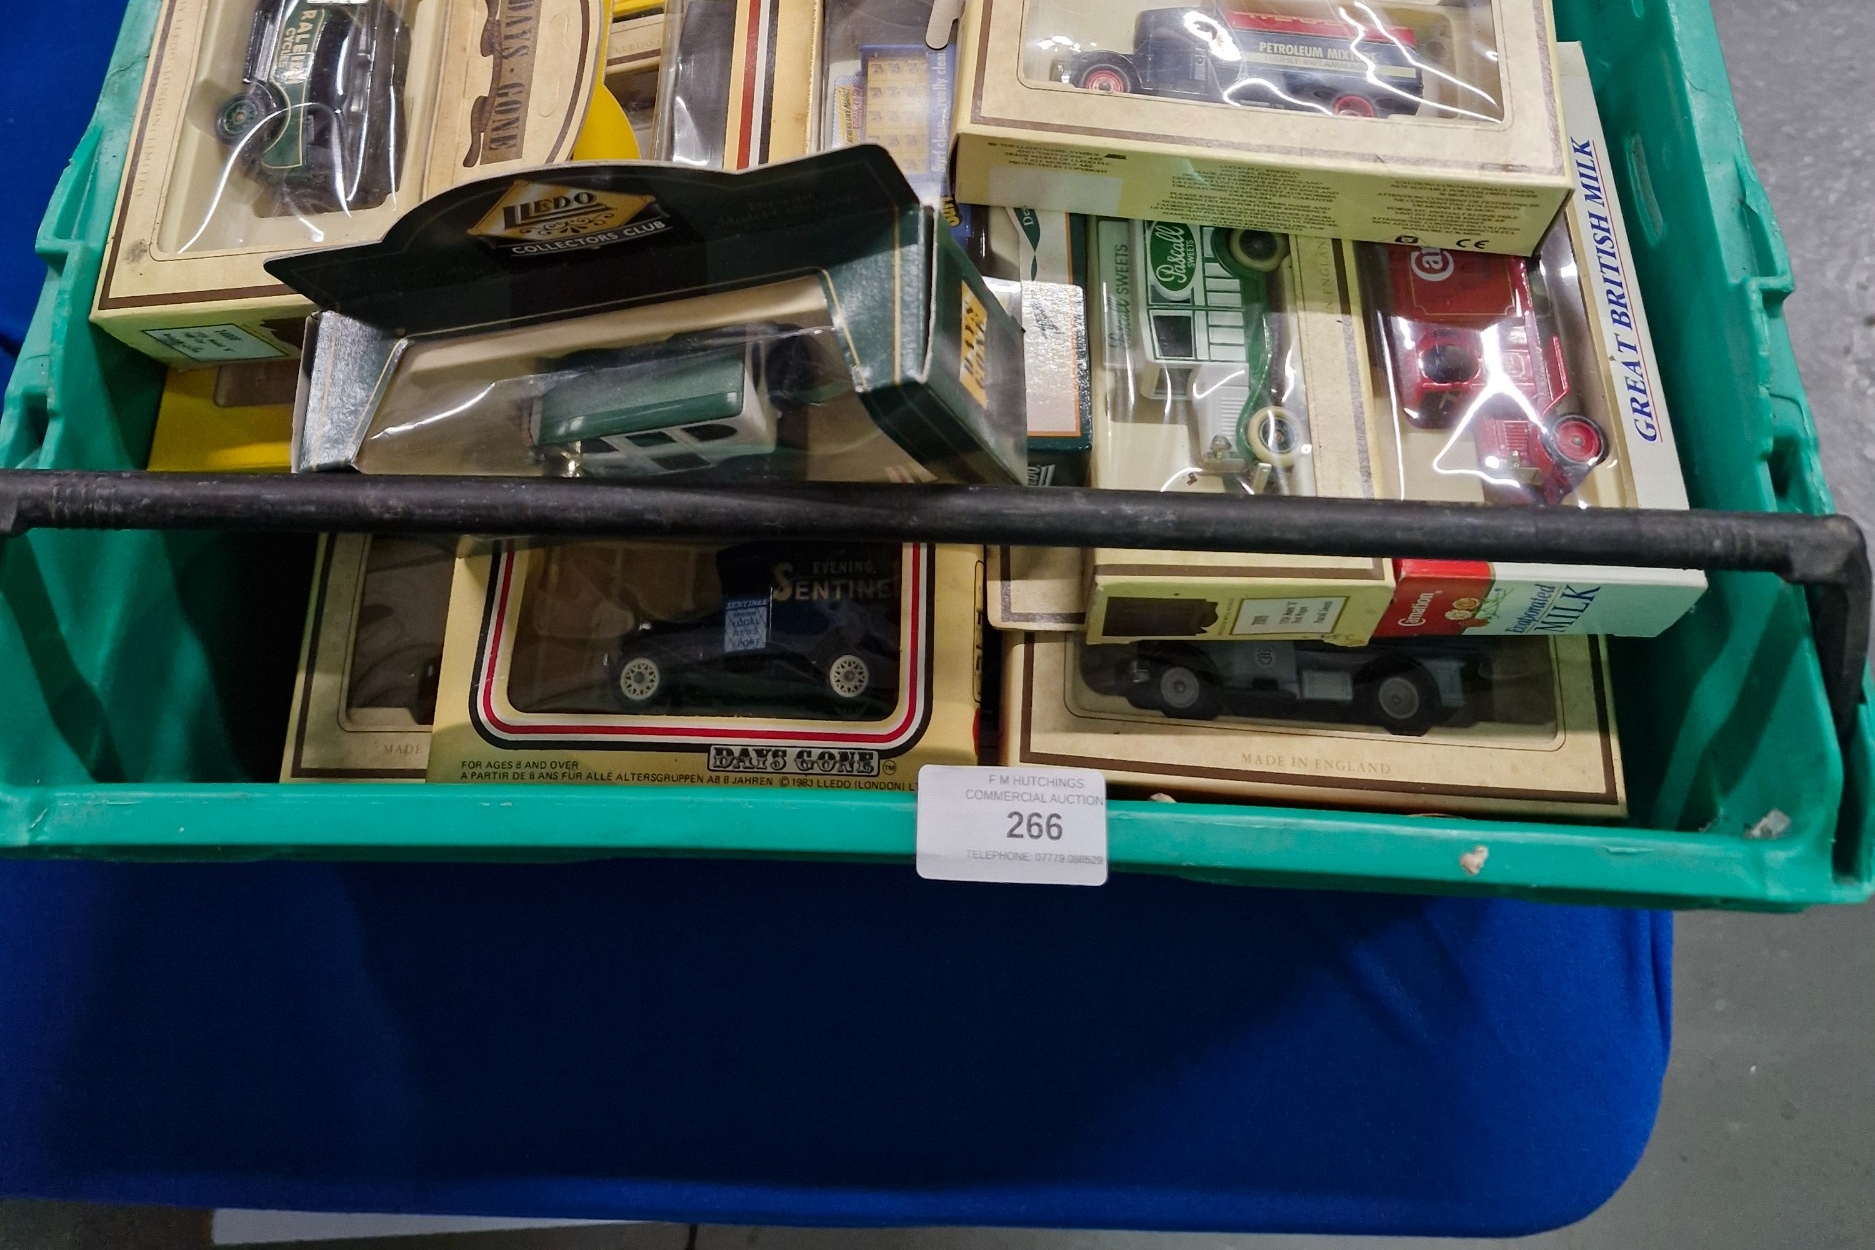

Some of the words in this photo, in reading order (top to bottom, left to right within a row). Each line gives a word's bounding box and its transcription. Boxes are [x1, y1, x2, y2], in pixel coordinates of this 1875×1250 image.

[1259, 42, 1323, 58] PETROLEUM
[1570, 135, 1605, 207] MILK
[503, 191, 599, 230] LLEDO
[512, 231, 618, 256] COLLECTORS
[623, 220, 667, 238] CLUB
[1155, 224, 1188, 283] Pascall
[1186, 239, 1195, 268] SWEETS
[1115, 244, 1129, 295] SWEETS
[1587, 210, 1632, 332] BRITISH
[1616, 332, 1658, 444] GREAT
[1397, 592, 1434, 627] Carnation
[1504, 583, 1556, 634] Evaporated
[1533, 584, 1602, 633] MILK
[461, 760, 482, 769] FOR
[485, 760, 514, 770] AGES
[515, 760, 522, 769] 8
[524, 760, 547, 770] AND
[550, 760, 579, 771] OVER
[712, 746, 788, 771] DAYS
[795, 749, 875, 774] GONE
[1241, 752, 1285, 767] MADE
[1291, 756, 1308, 769] IN
[1315, 758, 1391, 774] ENGLAND
[460, 772, 468, 780] A
[471, 772, 509, 781] PARTIR
[512, 772, 525, 781] DE
[529, 772, 535, 780] 8
[538, 772, 558, 781] ANS
[616, 772, 703, 784] ALTERSGRUPPEN
[707, 775, 720, 784] AB
[723, 775, 730, 784] 8
[732, 776, 773, 786] JAHREN
[817, 779, 851, 789] LLEDO
[965, 789, 1047, 804] COMMERCIAL
[1050, 794, 1104, 806] AUCTION
[989, 774, 996, 784] F
[1000, 775, 1009, 785] M
[1013, 776, 1084, 789] HUTCHINGS
[1006, 810, 1063, 841] 266
